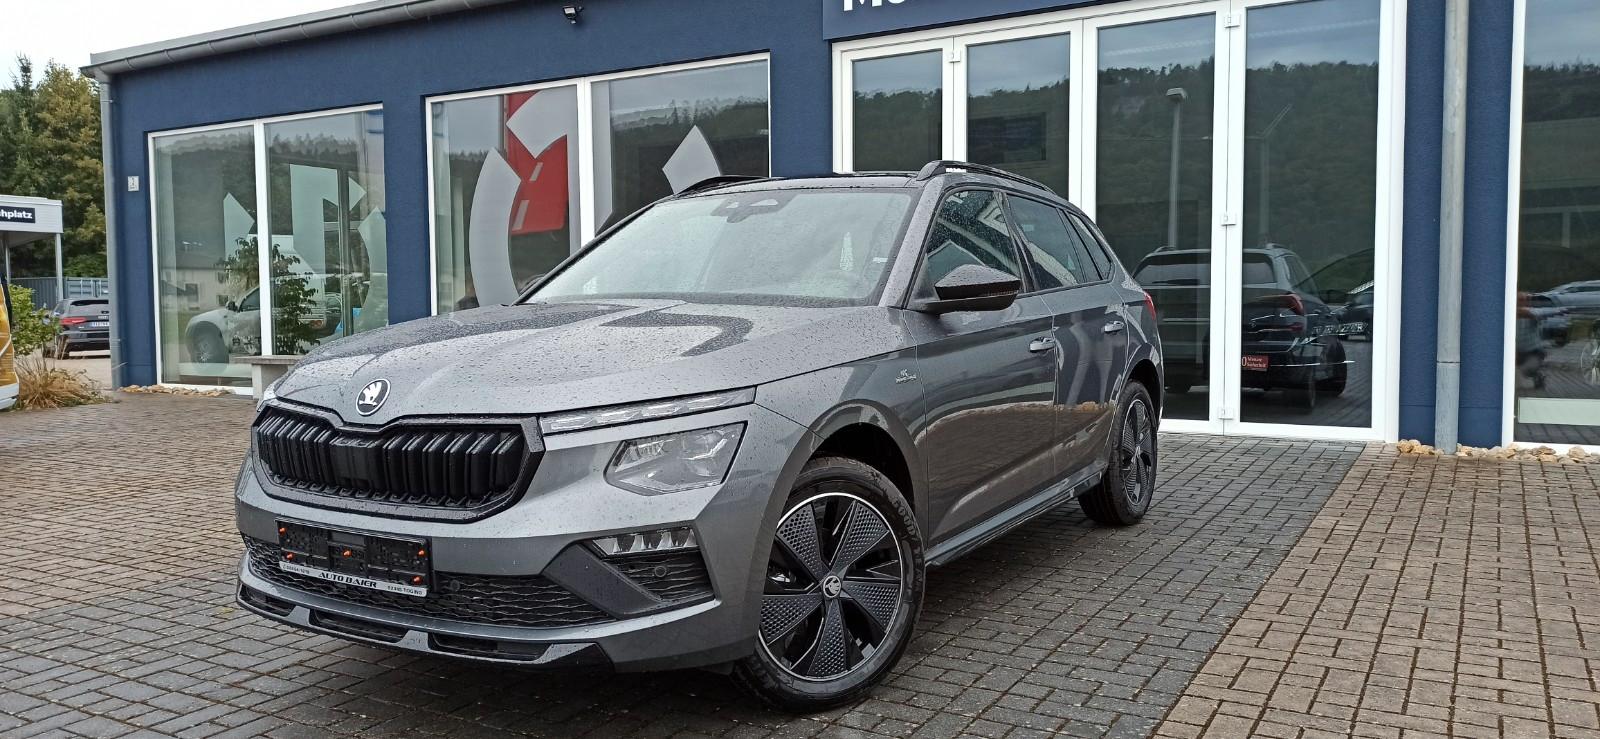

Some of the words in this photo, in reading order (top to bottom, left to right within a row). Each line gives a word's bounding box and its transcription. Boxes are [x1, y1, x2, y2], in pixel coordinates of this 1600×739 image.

[0, 209, 33, 220] hplatz
[319, 572, 344, 582] AUTO
[346, 577, 377, 588] BAIER
